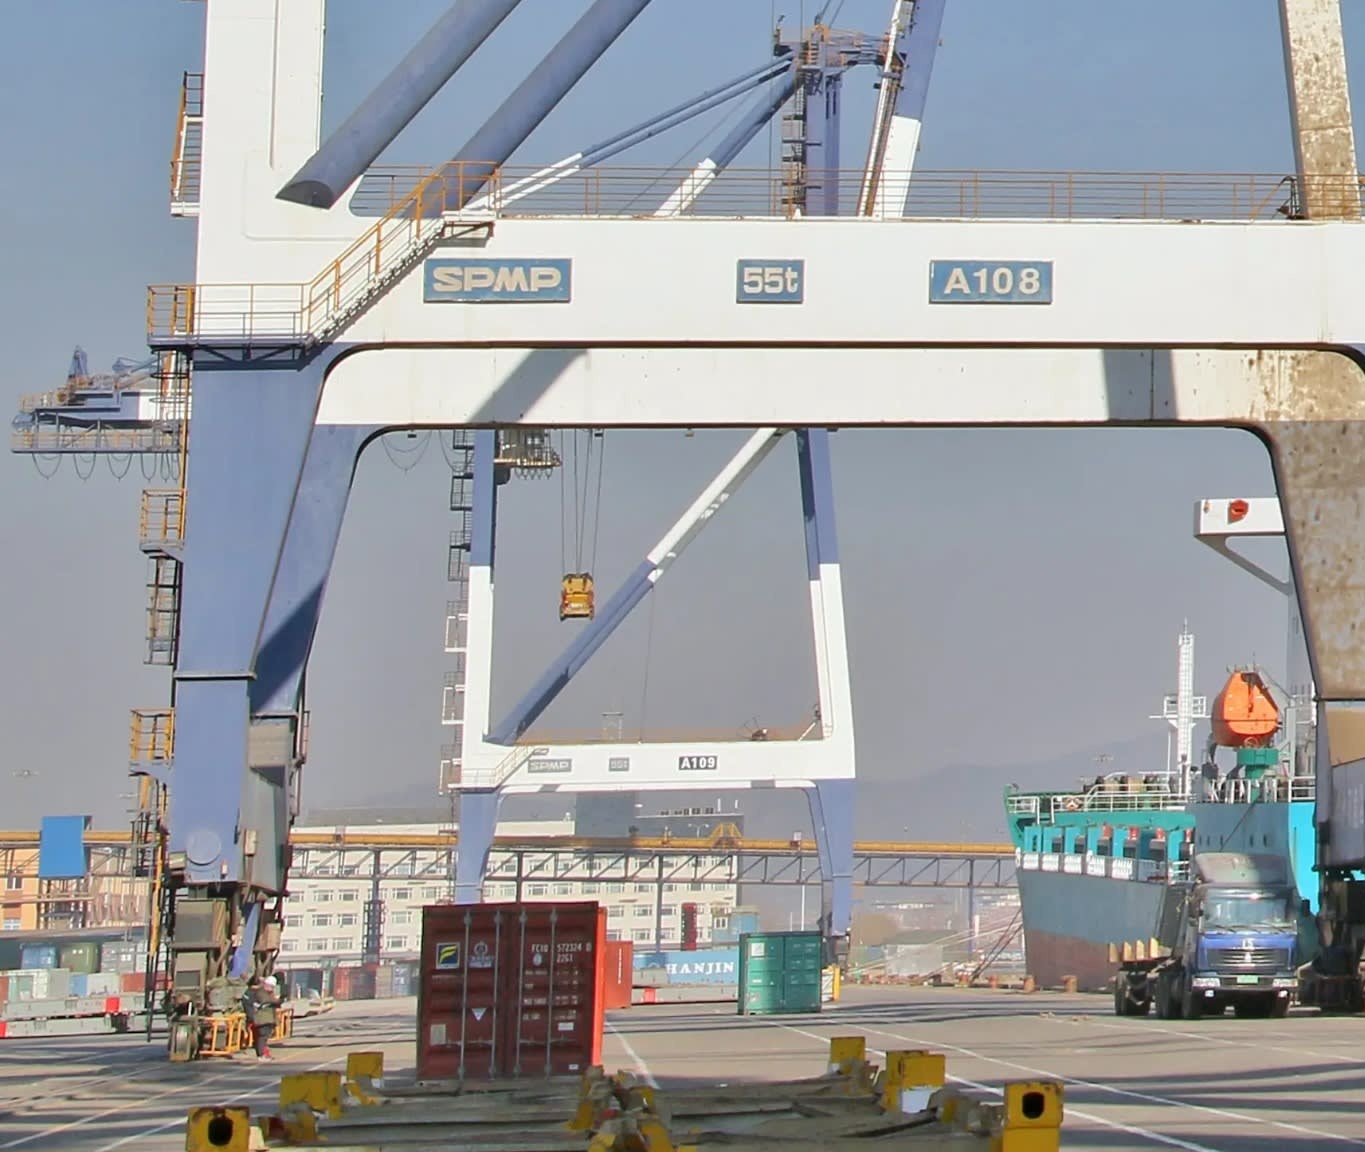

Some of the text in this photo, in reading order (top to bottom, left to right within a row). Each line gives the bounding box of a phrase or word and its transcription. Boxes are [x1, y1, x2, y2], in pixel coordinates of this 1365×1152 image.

[432, 266, 563, 293] SPMP
[742, 267, 798, 291] 55t
[943, 267, 1041, 296] A108
[680, 756, 716, 769] A109
[666, 961, 734, 975] HANJIN
